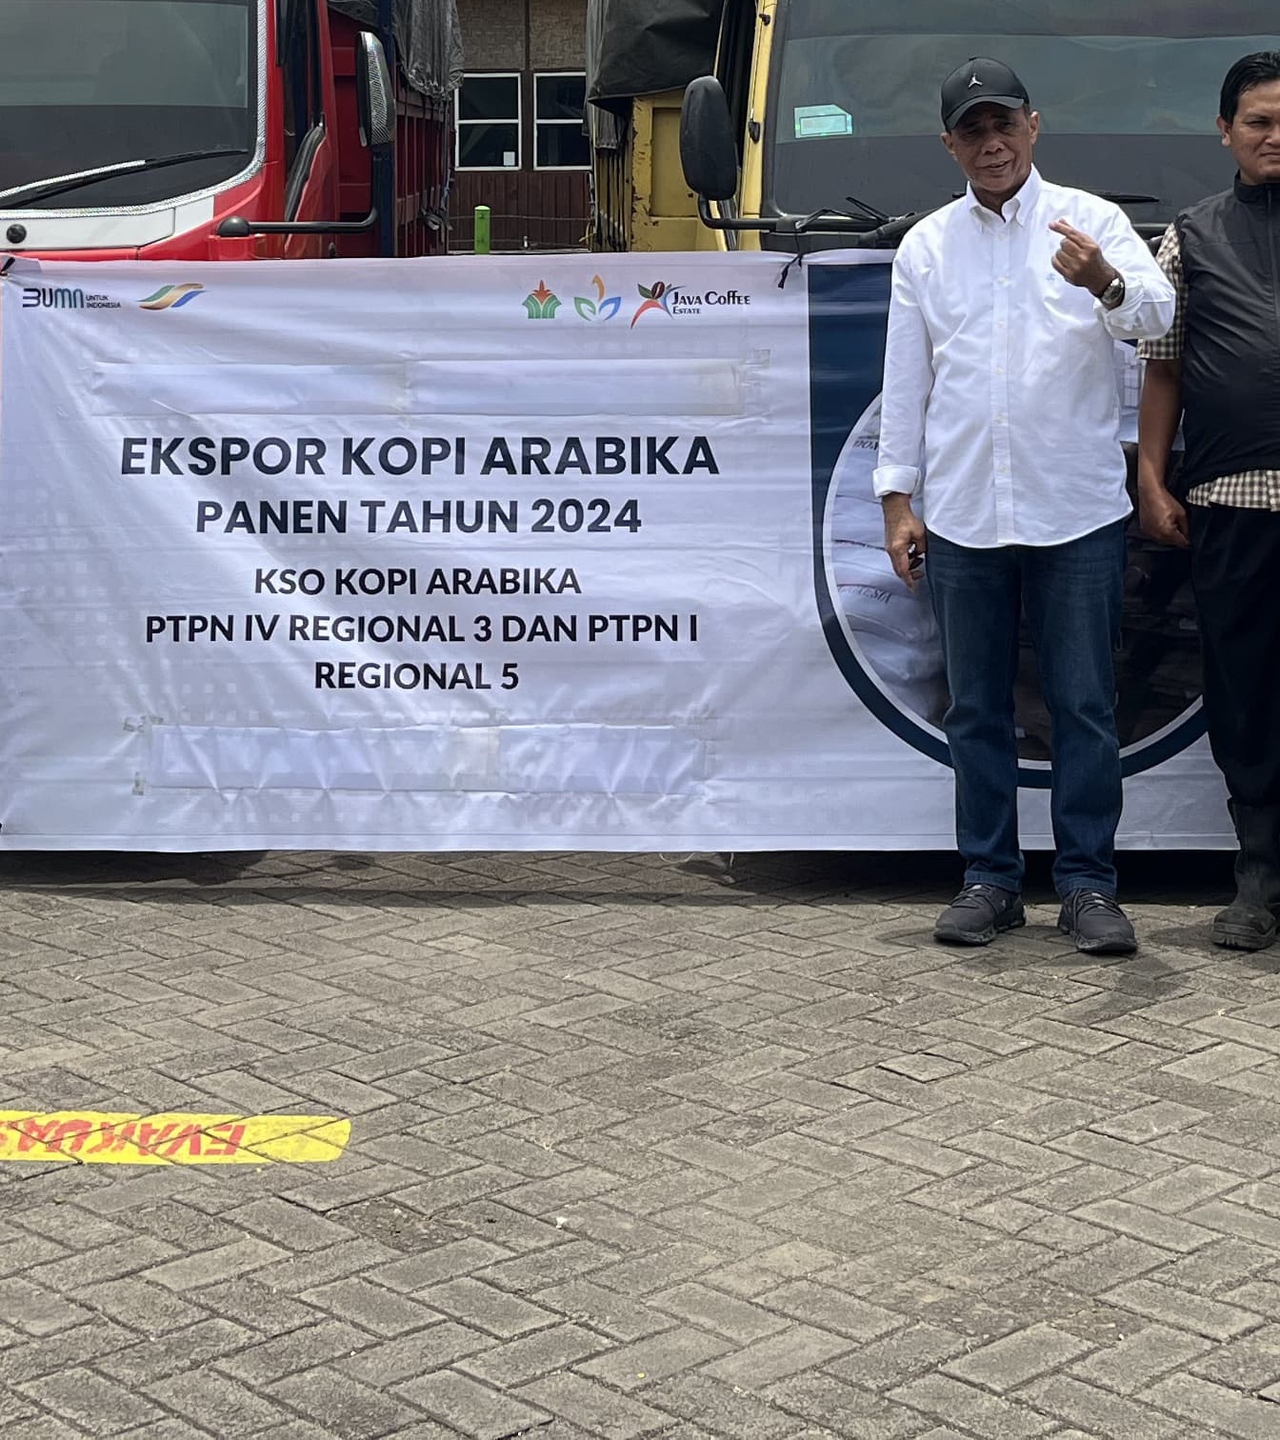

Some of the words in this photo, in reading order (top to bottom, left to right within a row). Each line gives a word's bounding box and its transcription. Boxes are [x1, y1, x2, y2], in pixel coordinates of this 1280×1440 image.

[86, 301, 121, 309] INDONESIA
[121, 436, 327, 476] EKSPOR
[341, 436, 466, 476] KOPI
[480, 436, 720, 476] ARABIKA
[196, 500, 348, 534] PANEN
[360, 500, 518, 534] TAHUN
[531, 498, 642, 533] 2024
[255, 568, 326, 595] KSO
[335, 568, 417, 596] KOPI
[426, 568, 582, 595] ARABIKA
[146, 614, 234, 643] PTPN
[245, 614, 281, 642] IV
[289, 614, 465, 643] REGIONAL
[473, 615, 492, 642] 3
[502, 615, 577, 642] DAN
[588, 614, 678, 642] PTPN
[689, 614, 698, 642] I
[315, 661, 492, 690] REGIONAL
[500, 662, 519, 690] 5
